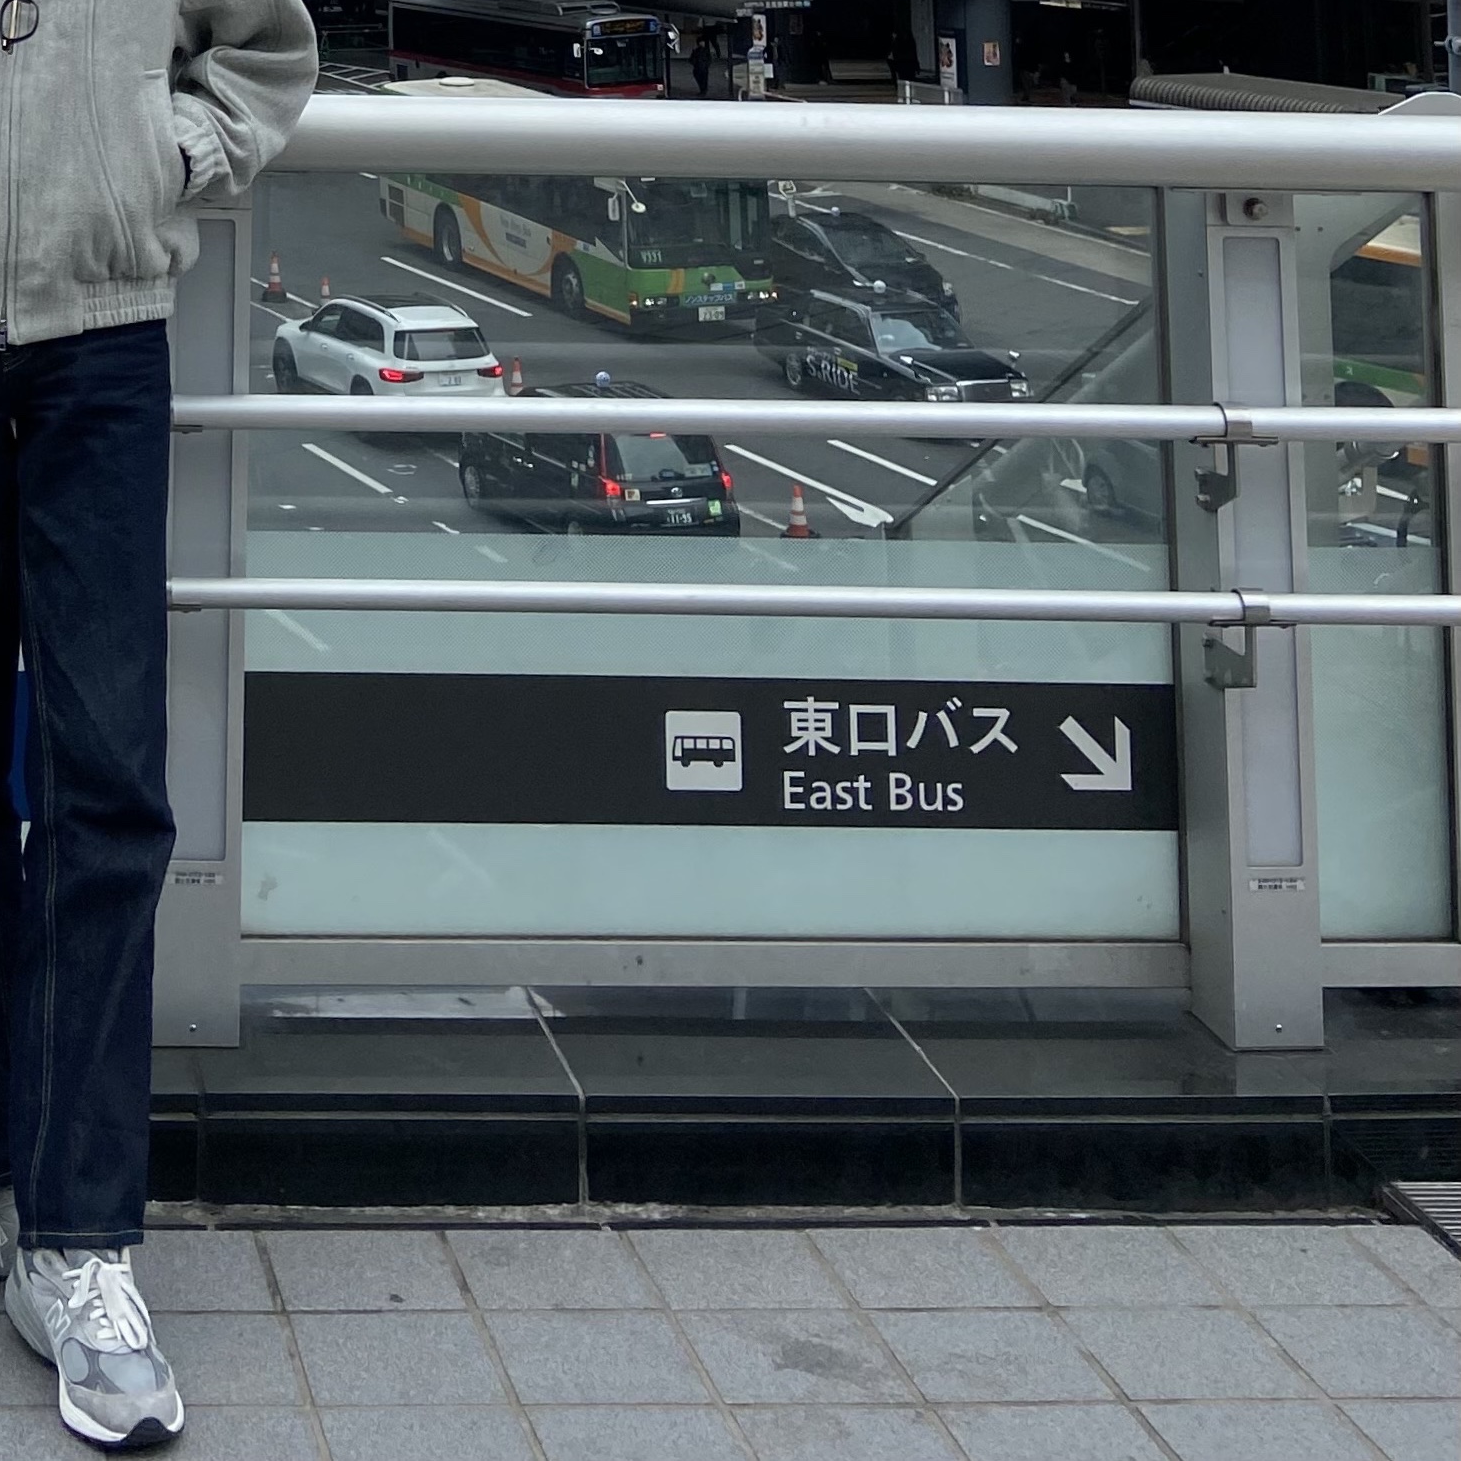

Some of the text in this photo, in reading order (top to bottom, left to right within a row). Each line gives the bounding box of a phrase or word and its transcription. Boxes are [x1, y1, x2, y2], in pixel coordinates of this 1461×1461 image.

[806, 354, 861, 396] S.RIDE
[783, 695, 1019, 757] 東口バス
[783, 770, 965, 812] East Bus
